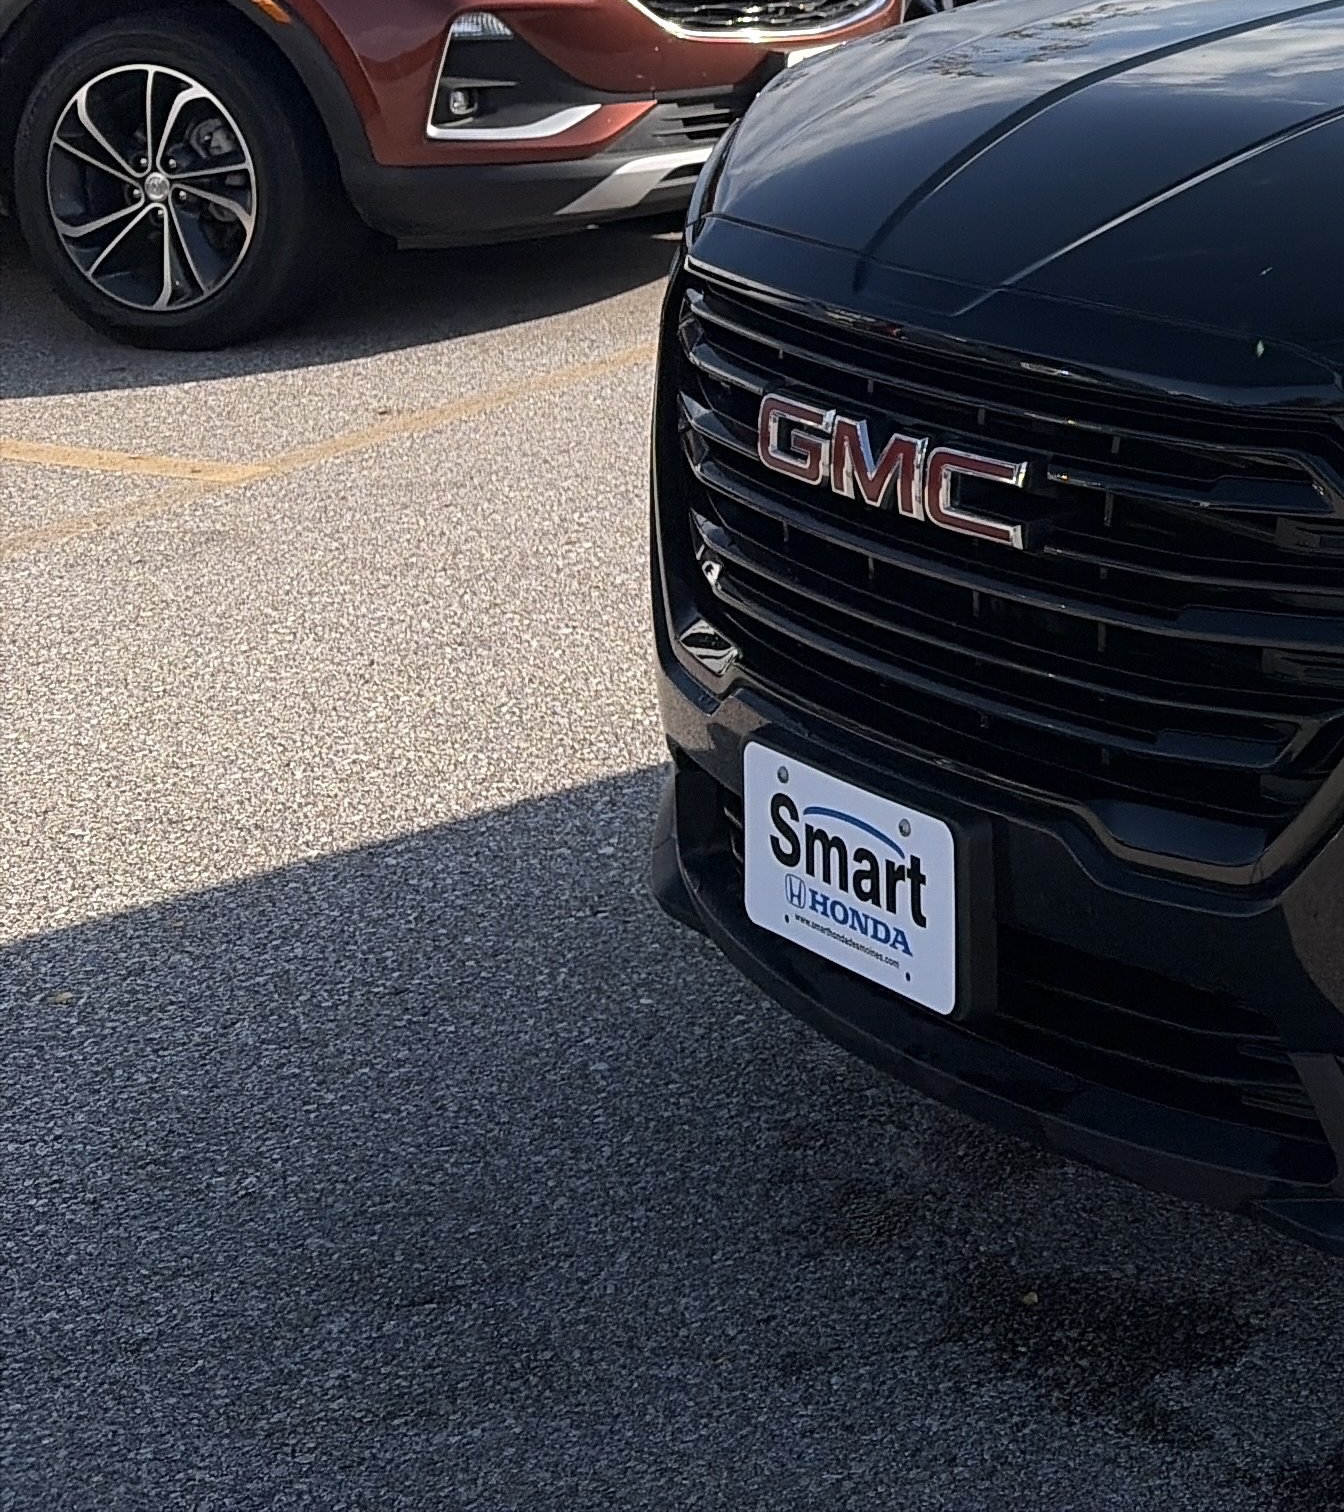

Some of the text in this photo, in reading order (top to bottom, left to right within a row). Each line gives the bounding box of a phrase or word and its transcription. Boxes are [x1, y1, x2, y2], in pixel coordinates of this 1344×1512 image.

[758, 393, 1028, 550] GMC
[769, 792, 927, 929] Smart
[808, 887, 914, 957] HONDA
